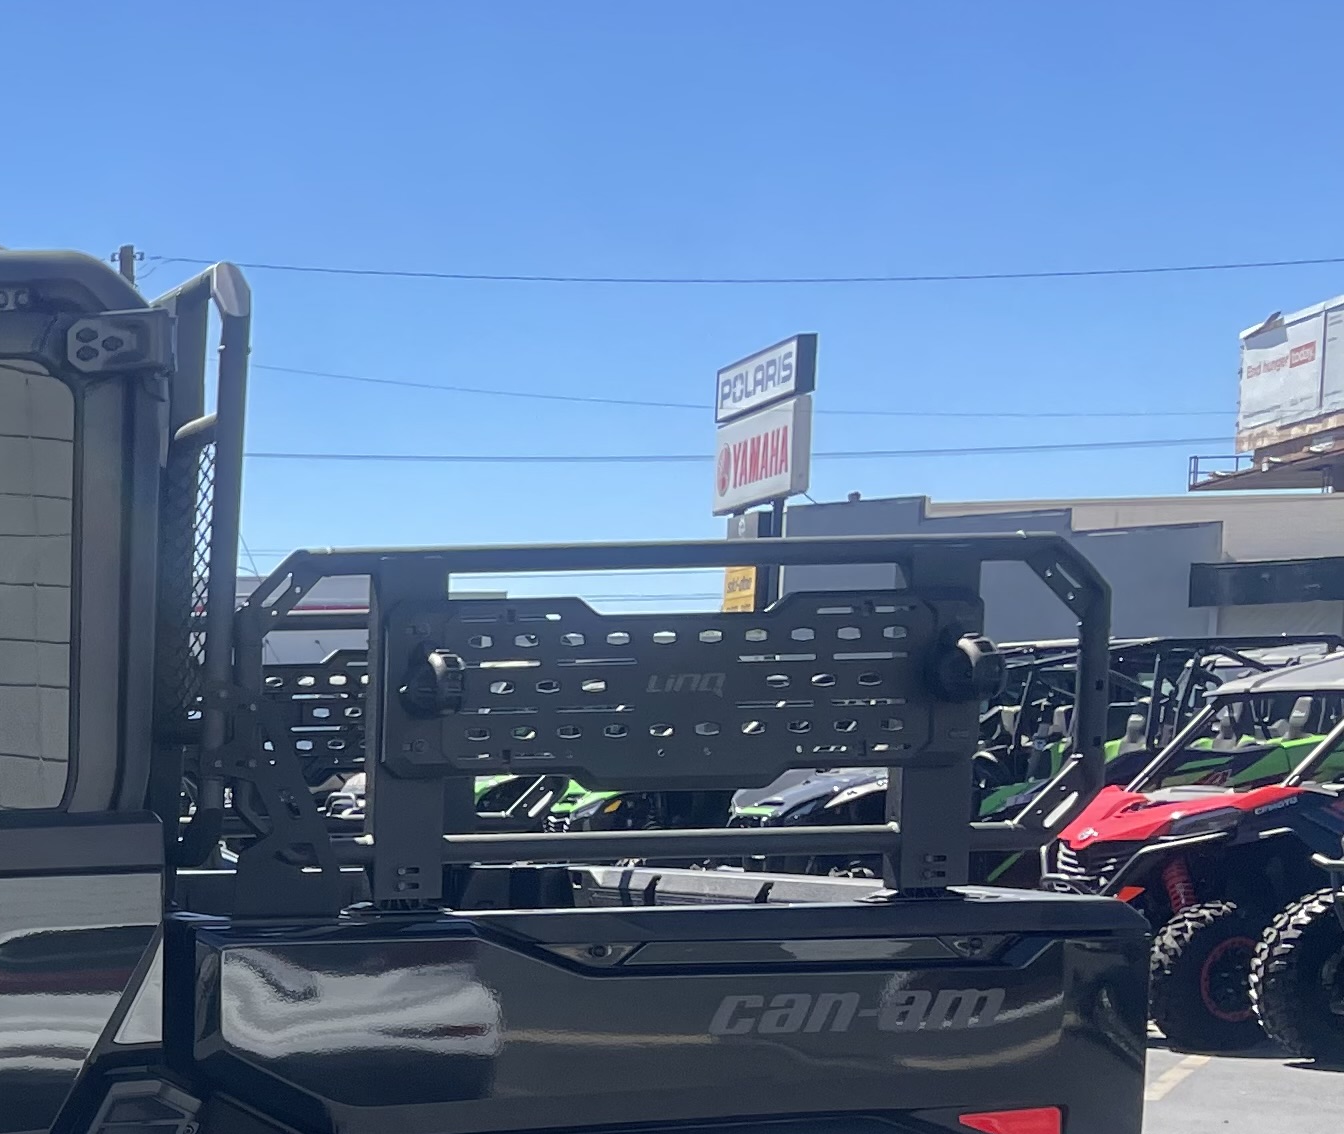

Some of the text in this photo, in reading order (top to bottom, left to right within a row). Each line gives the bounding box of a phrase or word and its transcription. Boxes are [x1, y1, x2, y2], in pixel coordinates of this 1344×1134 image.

[719, 351, 793, 409] POLARIS
[732, 425, 789, 489] YAMAHA
[708, 987, 1006, 1035] can-am
